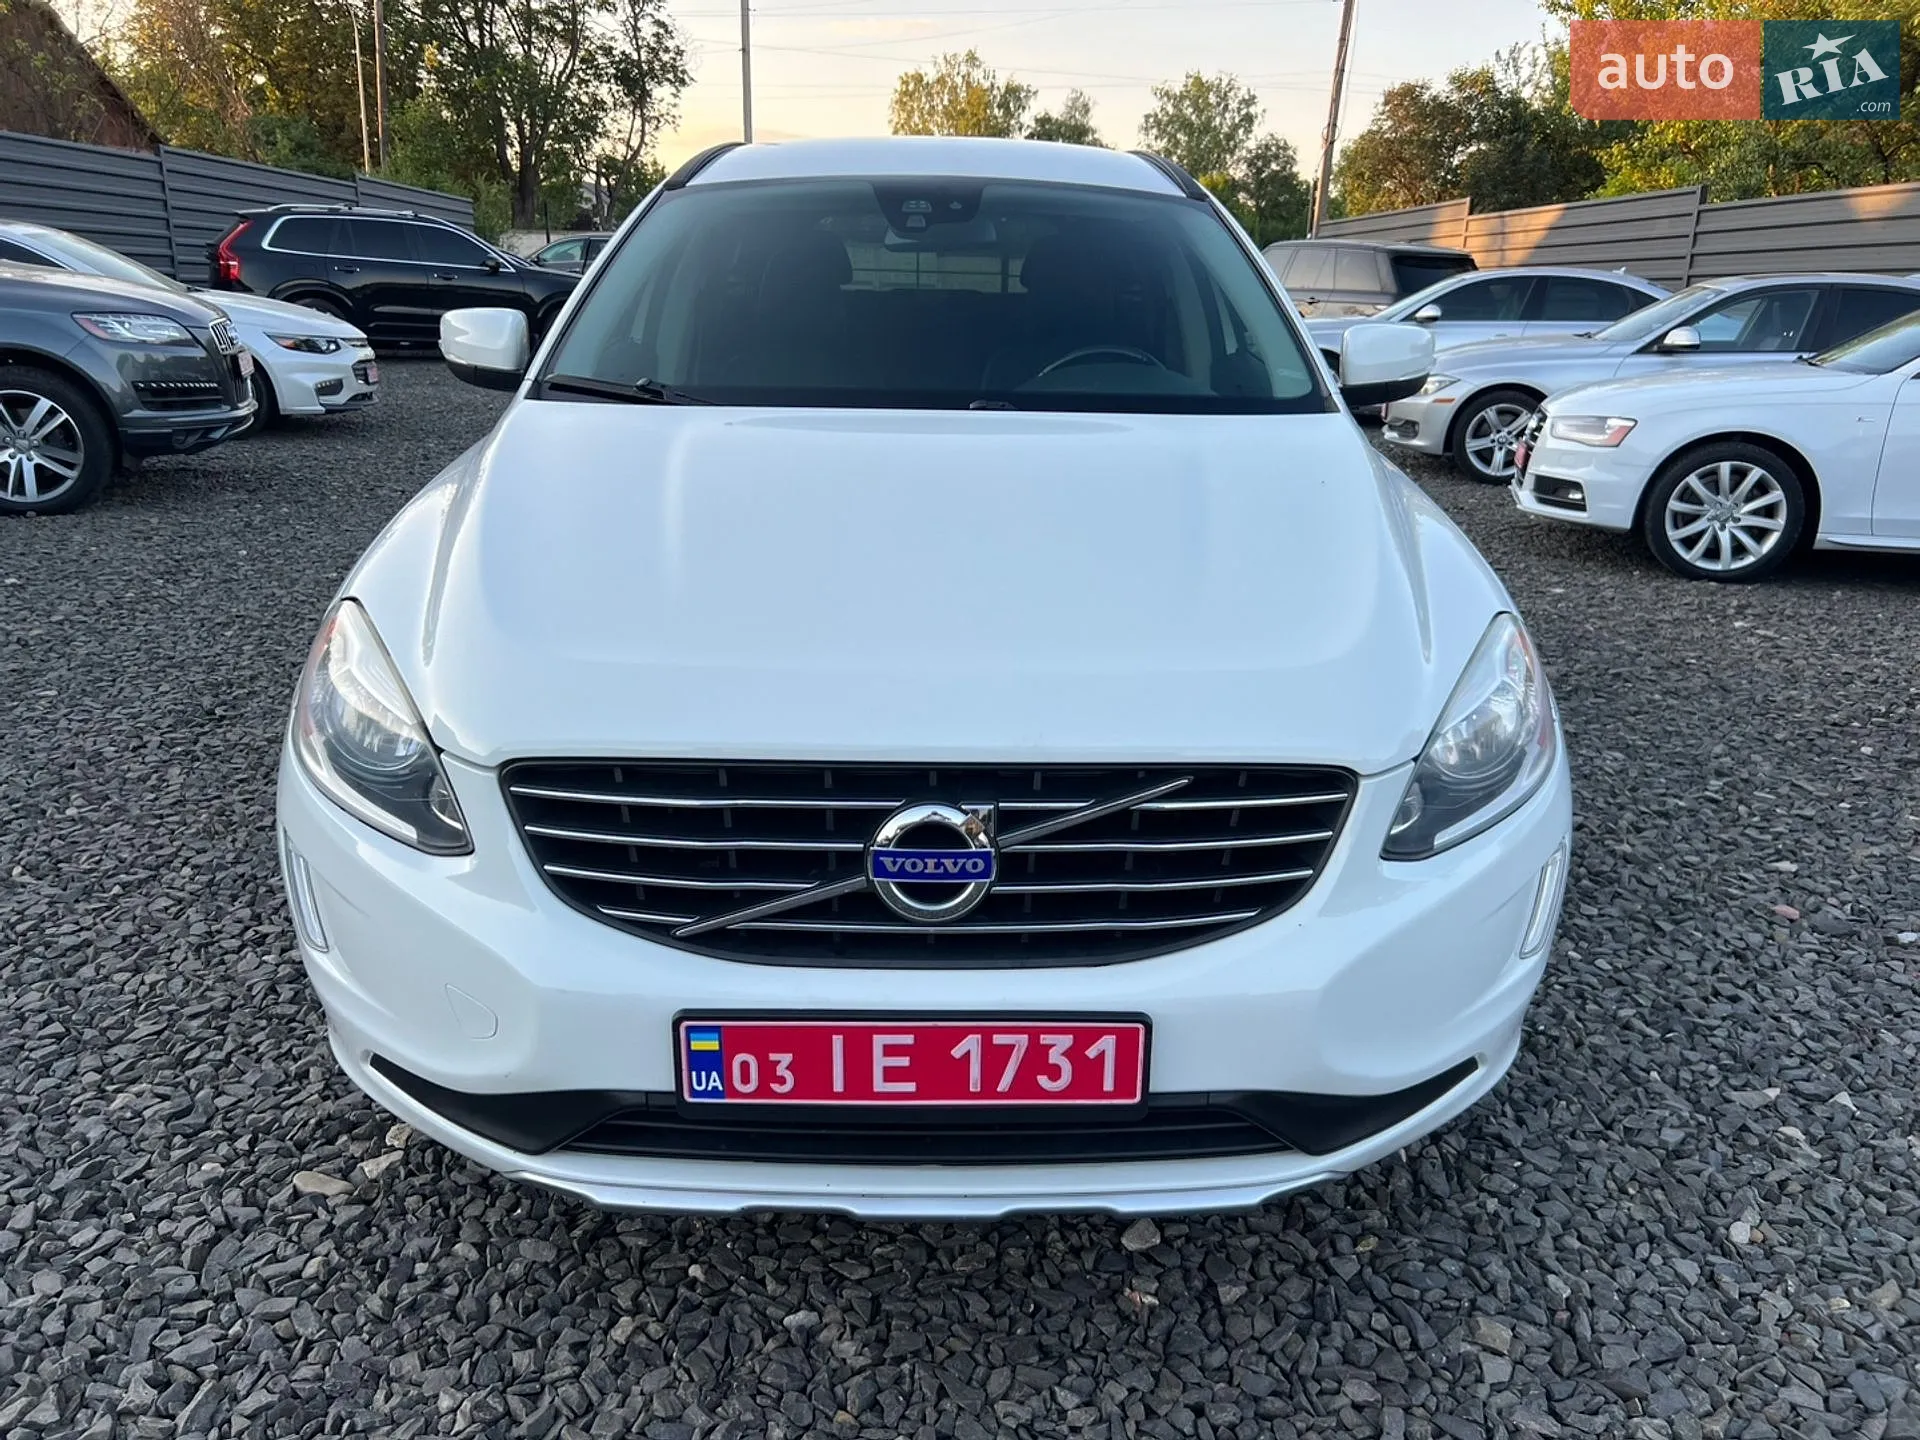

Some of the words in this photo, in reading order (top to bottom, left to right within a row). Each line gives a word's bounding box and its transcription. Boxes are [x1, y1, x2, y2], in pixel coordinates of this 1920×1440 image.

[879, 857, 985, 874] VOLVO
[732, 1053, 795, 1094] 03
[832, 1034, 916, 1092] IE
[950, 1034, 1117, 1092] 1731
[692, 1070, 723, 1091] UA
